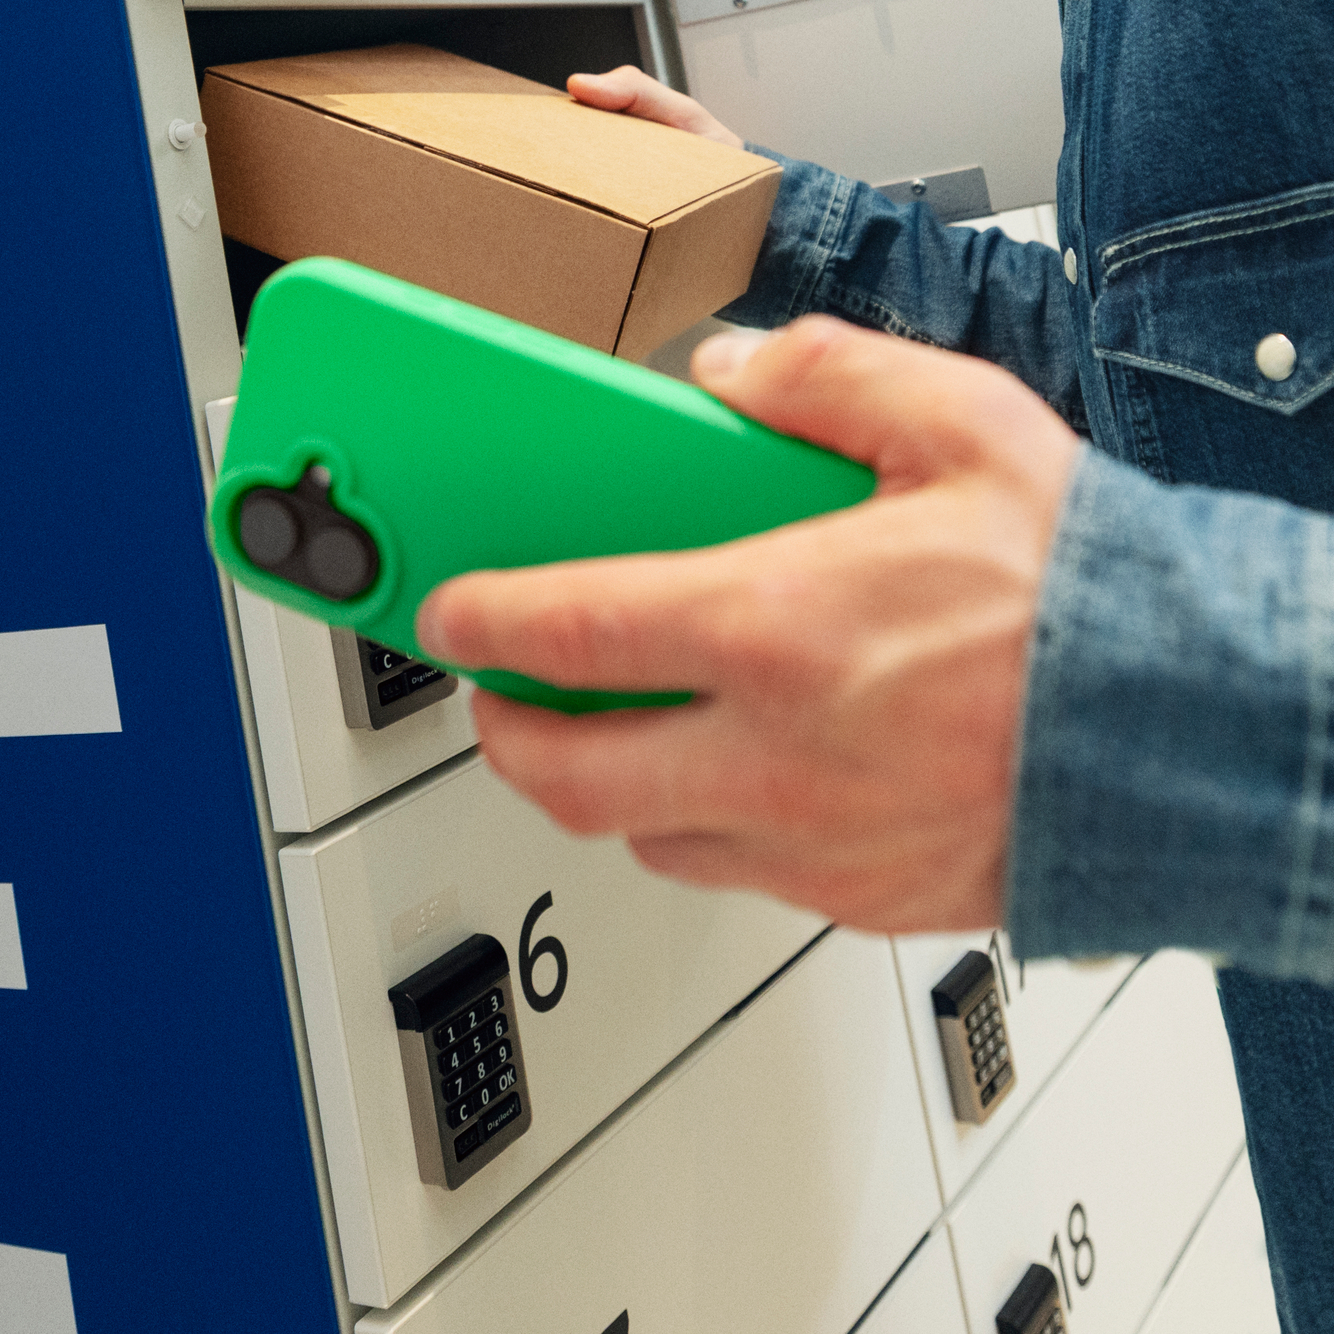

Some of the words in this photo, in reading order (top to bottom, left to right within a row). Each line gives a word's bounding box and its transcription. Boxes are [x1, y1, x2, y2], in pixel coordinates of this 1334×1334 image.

[384, 654, 392, 668] C
[518, 890, 568, 1013] 6
[989, 930, 1025, 1004] 1
[448, 1027, 455, 1043] 1
[469, 1011, 477, 1028] 2
[491, 995, 498, 1012] 3
[451, 1052, 459, 1068] 4
[473, 1036, 481, 1053] 5
[495, 1021, 502, 1037] 6
[455, 1078, 462, 1095] 7
[478, 1062, 485, 1079] 8
[499, 1046, 507, 1062] 9
[460, 1105, 467, 1120] C
[481, 1088, 489, 1105] 0
[499, 1068, 515, 1091] OK
[1051, 1202, 1095, 1311] 18
